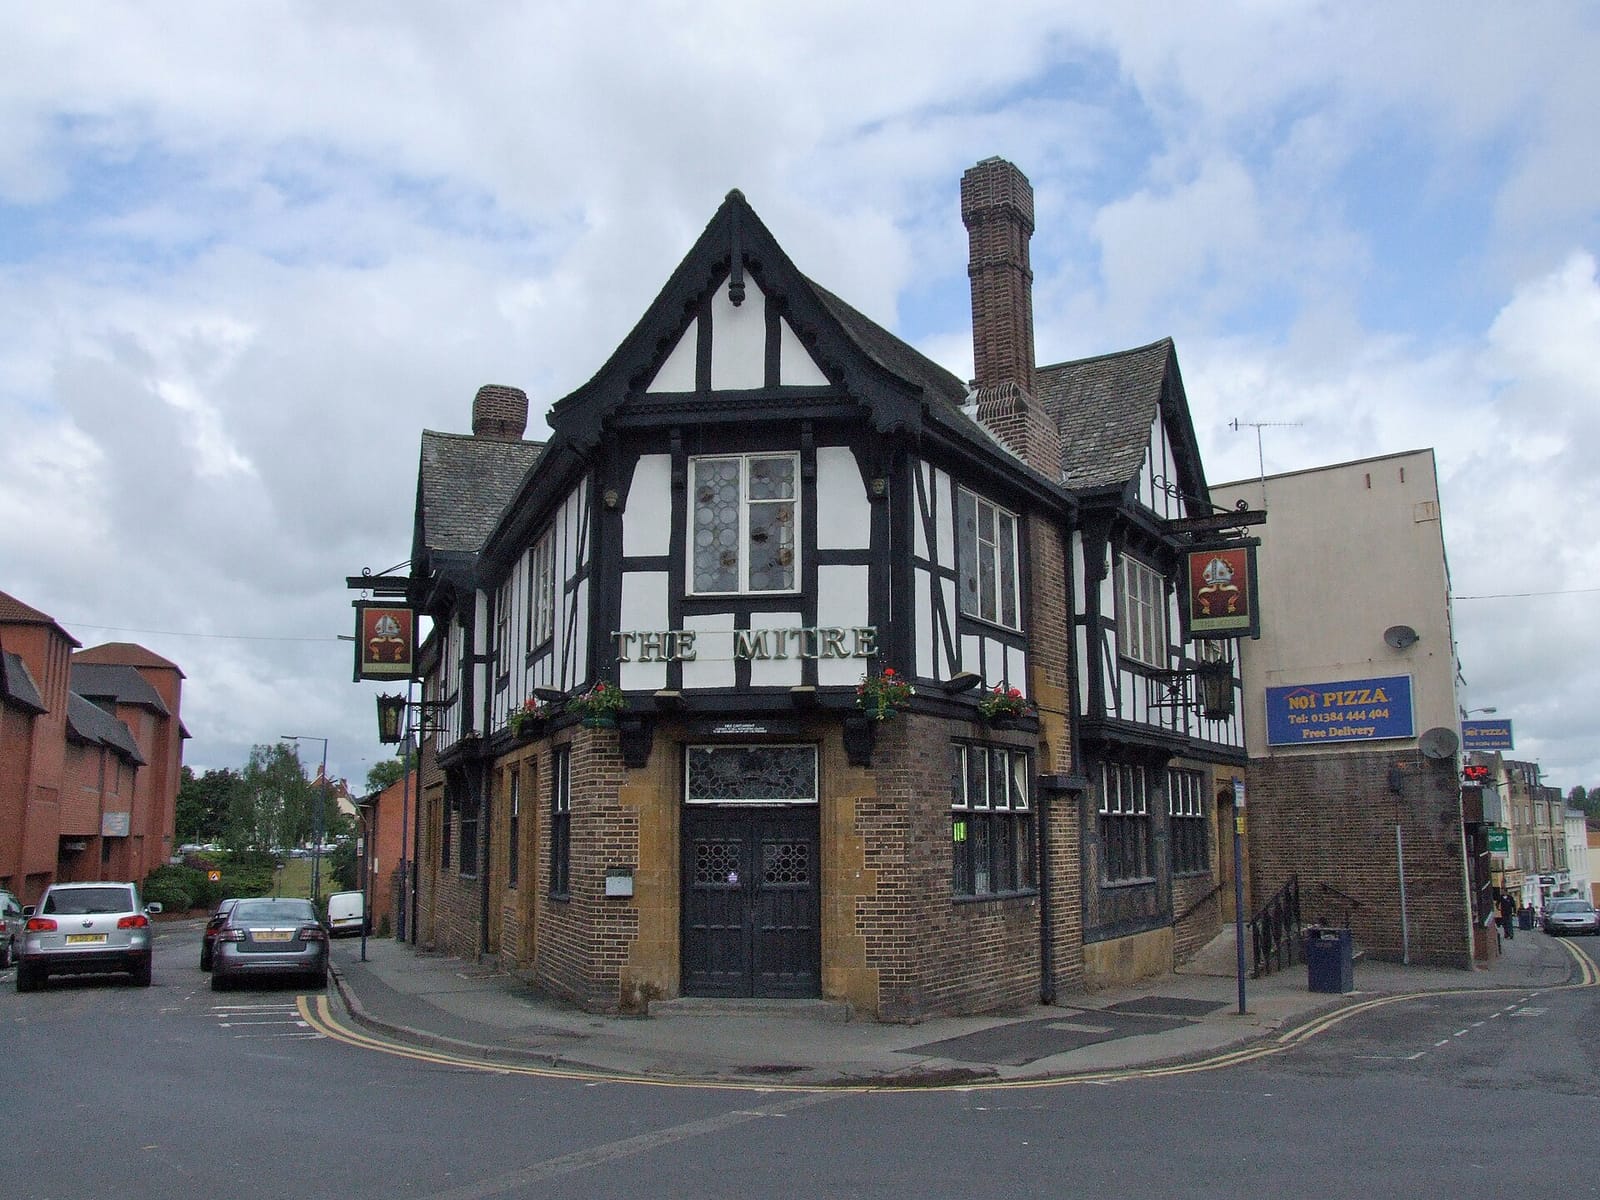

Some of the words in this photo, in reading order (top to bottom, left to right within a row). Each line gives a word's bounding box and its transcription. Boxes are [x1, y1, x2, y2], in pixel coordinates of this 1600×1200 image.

[610, 630, 697, 662] THE
[733, 626, 879, 660] MITRE
[1323, 688, 1388, 707] PIZZA
[1288, 714, 1308, 724] Tel:
[1311, 711, 1344, 723] 01384
[1346, 710, 1366, 720] 444
[1368, 708, 1389, 719] 404
[1302, 728, 1327, 738] Free
[1328, 726, 1376, 737] Delivery
